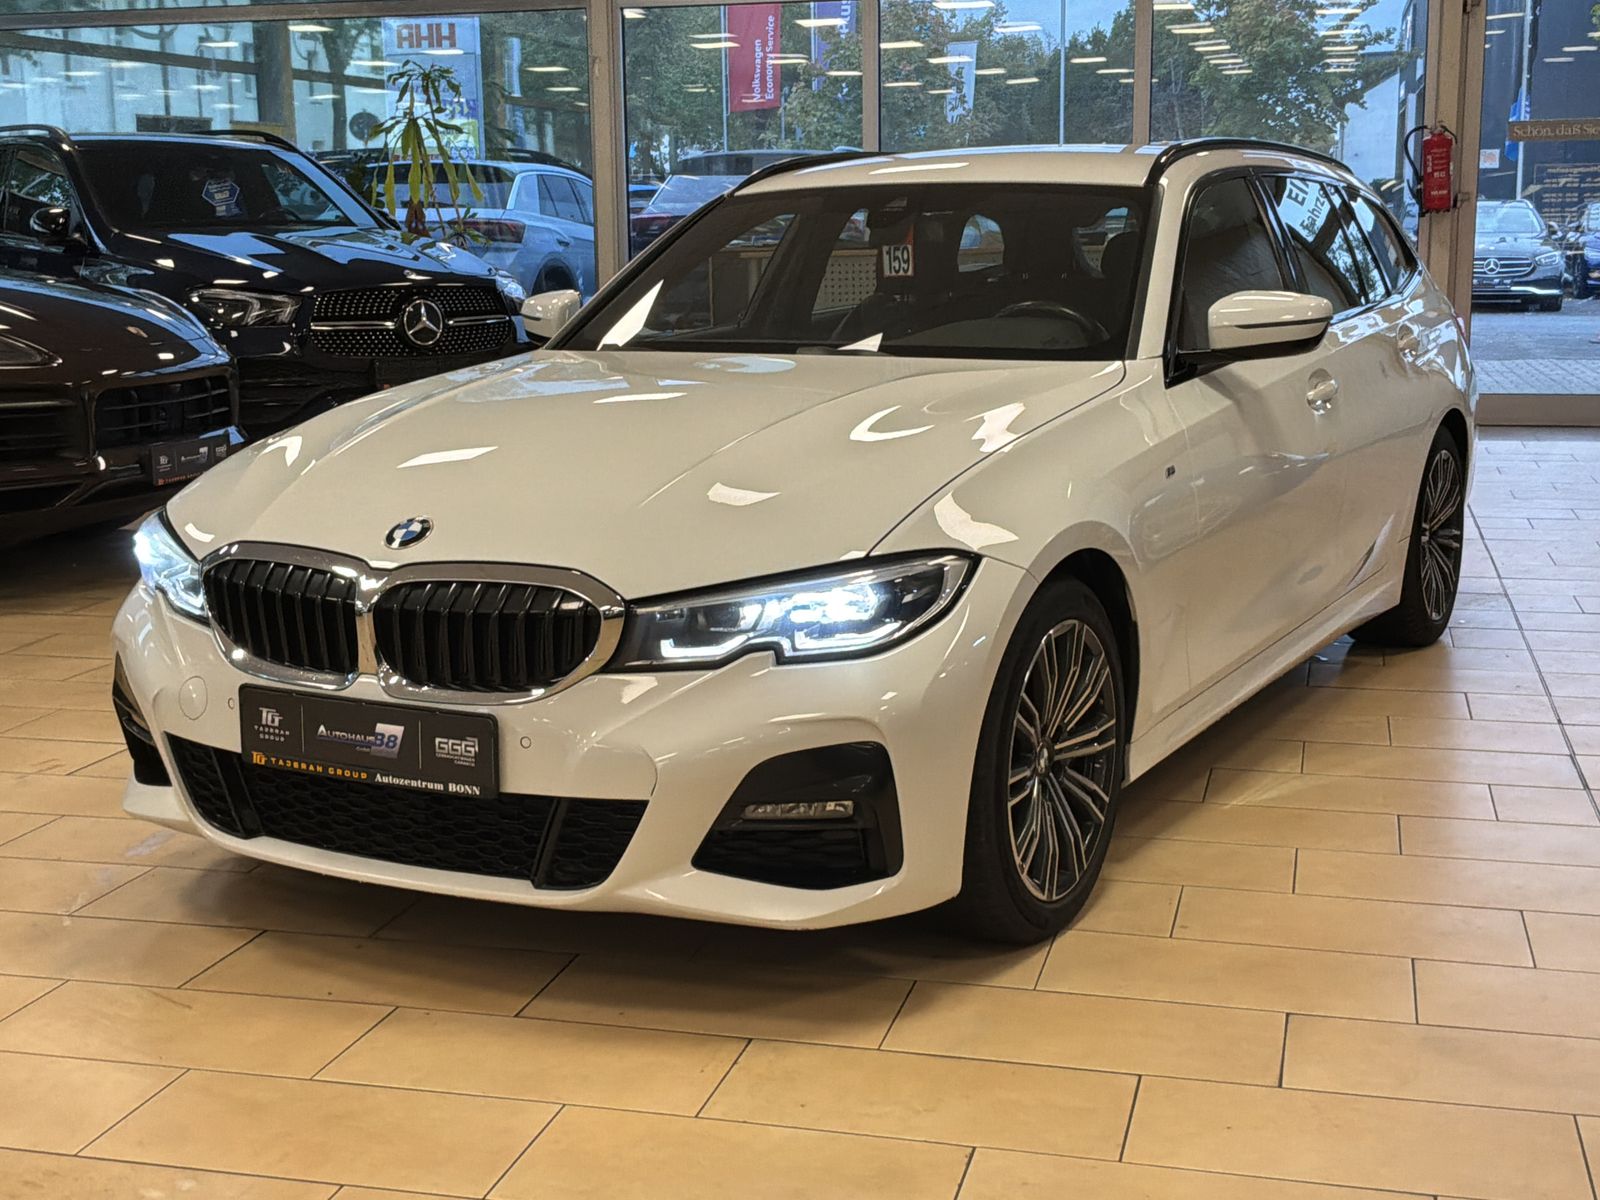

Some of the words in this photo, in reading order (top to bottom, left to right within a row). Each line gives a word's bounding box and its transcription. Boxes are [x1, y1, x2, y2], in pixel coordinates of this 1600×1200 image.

[766, 15, 775, 52] Service
[752, 39, 763, 101] Volkswagen
[765, 54, 774, 99] Economy
[886, 245, 910, 274] 159
[260, 733, 285, 742] GROUP
[435, 737, 476, 757] GGG
[328, 767, 368, 779] GROUP
[375, 773, 444, 791] Autozentrum
[448, 783, 480, 796] BONN
